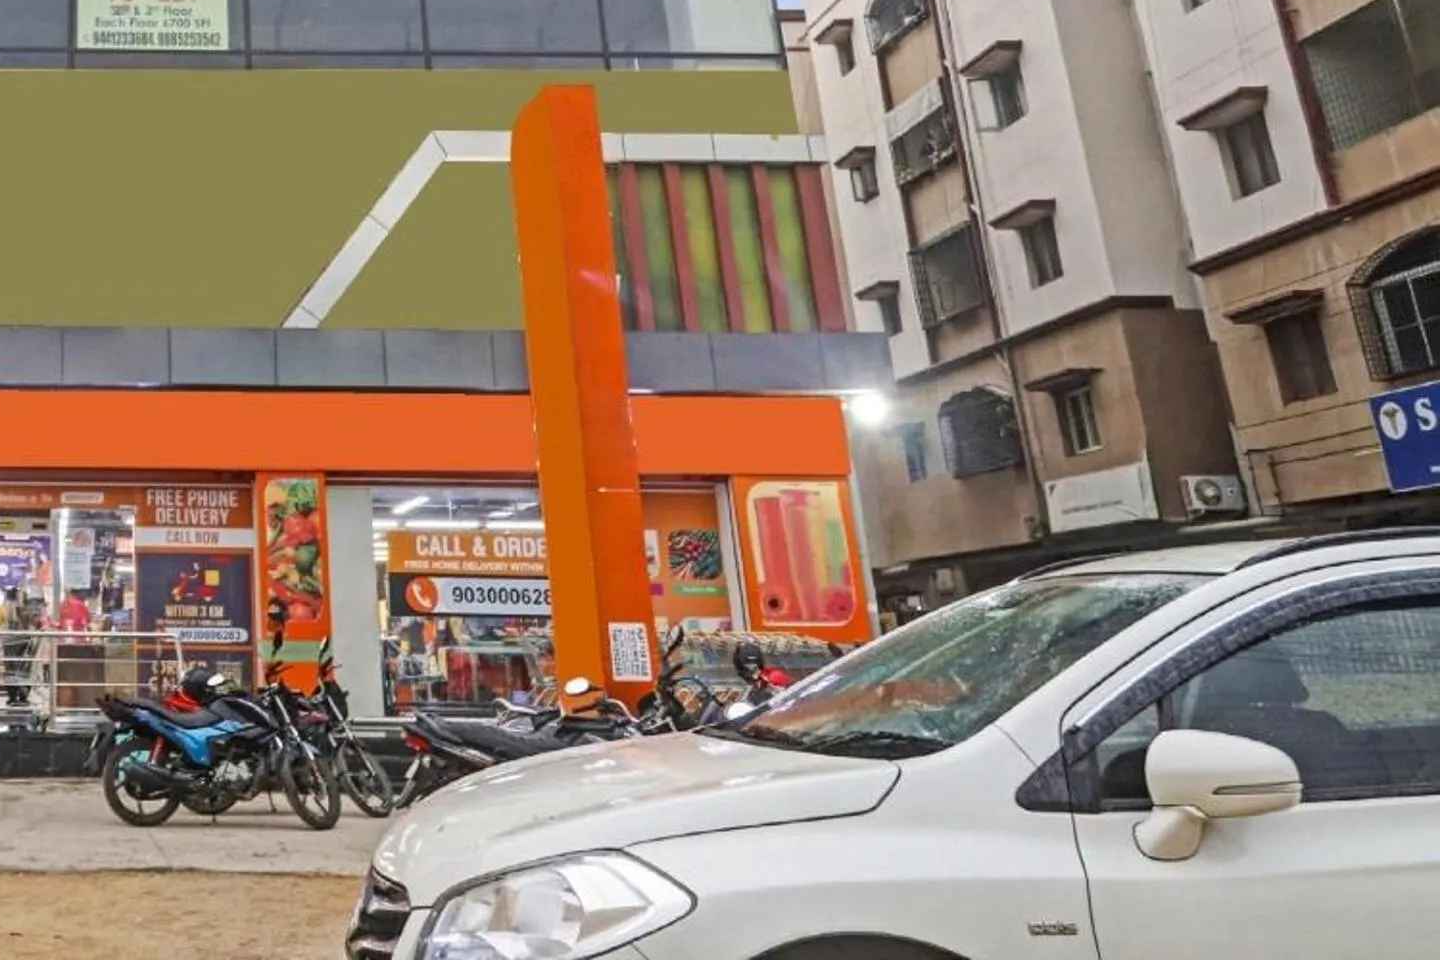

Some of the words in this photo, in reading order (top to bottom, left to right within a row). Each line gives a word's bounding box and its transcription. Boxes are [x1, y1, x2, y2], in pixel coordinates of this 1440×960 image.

[146, 489, 185, 507] FREE
[187, 490, 240, 508] PHONE
[155, 508, 230, 525] DELIVERY
[415, 534, 466, 557] CALL
[472, 535, 487, 557] &
